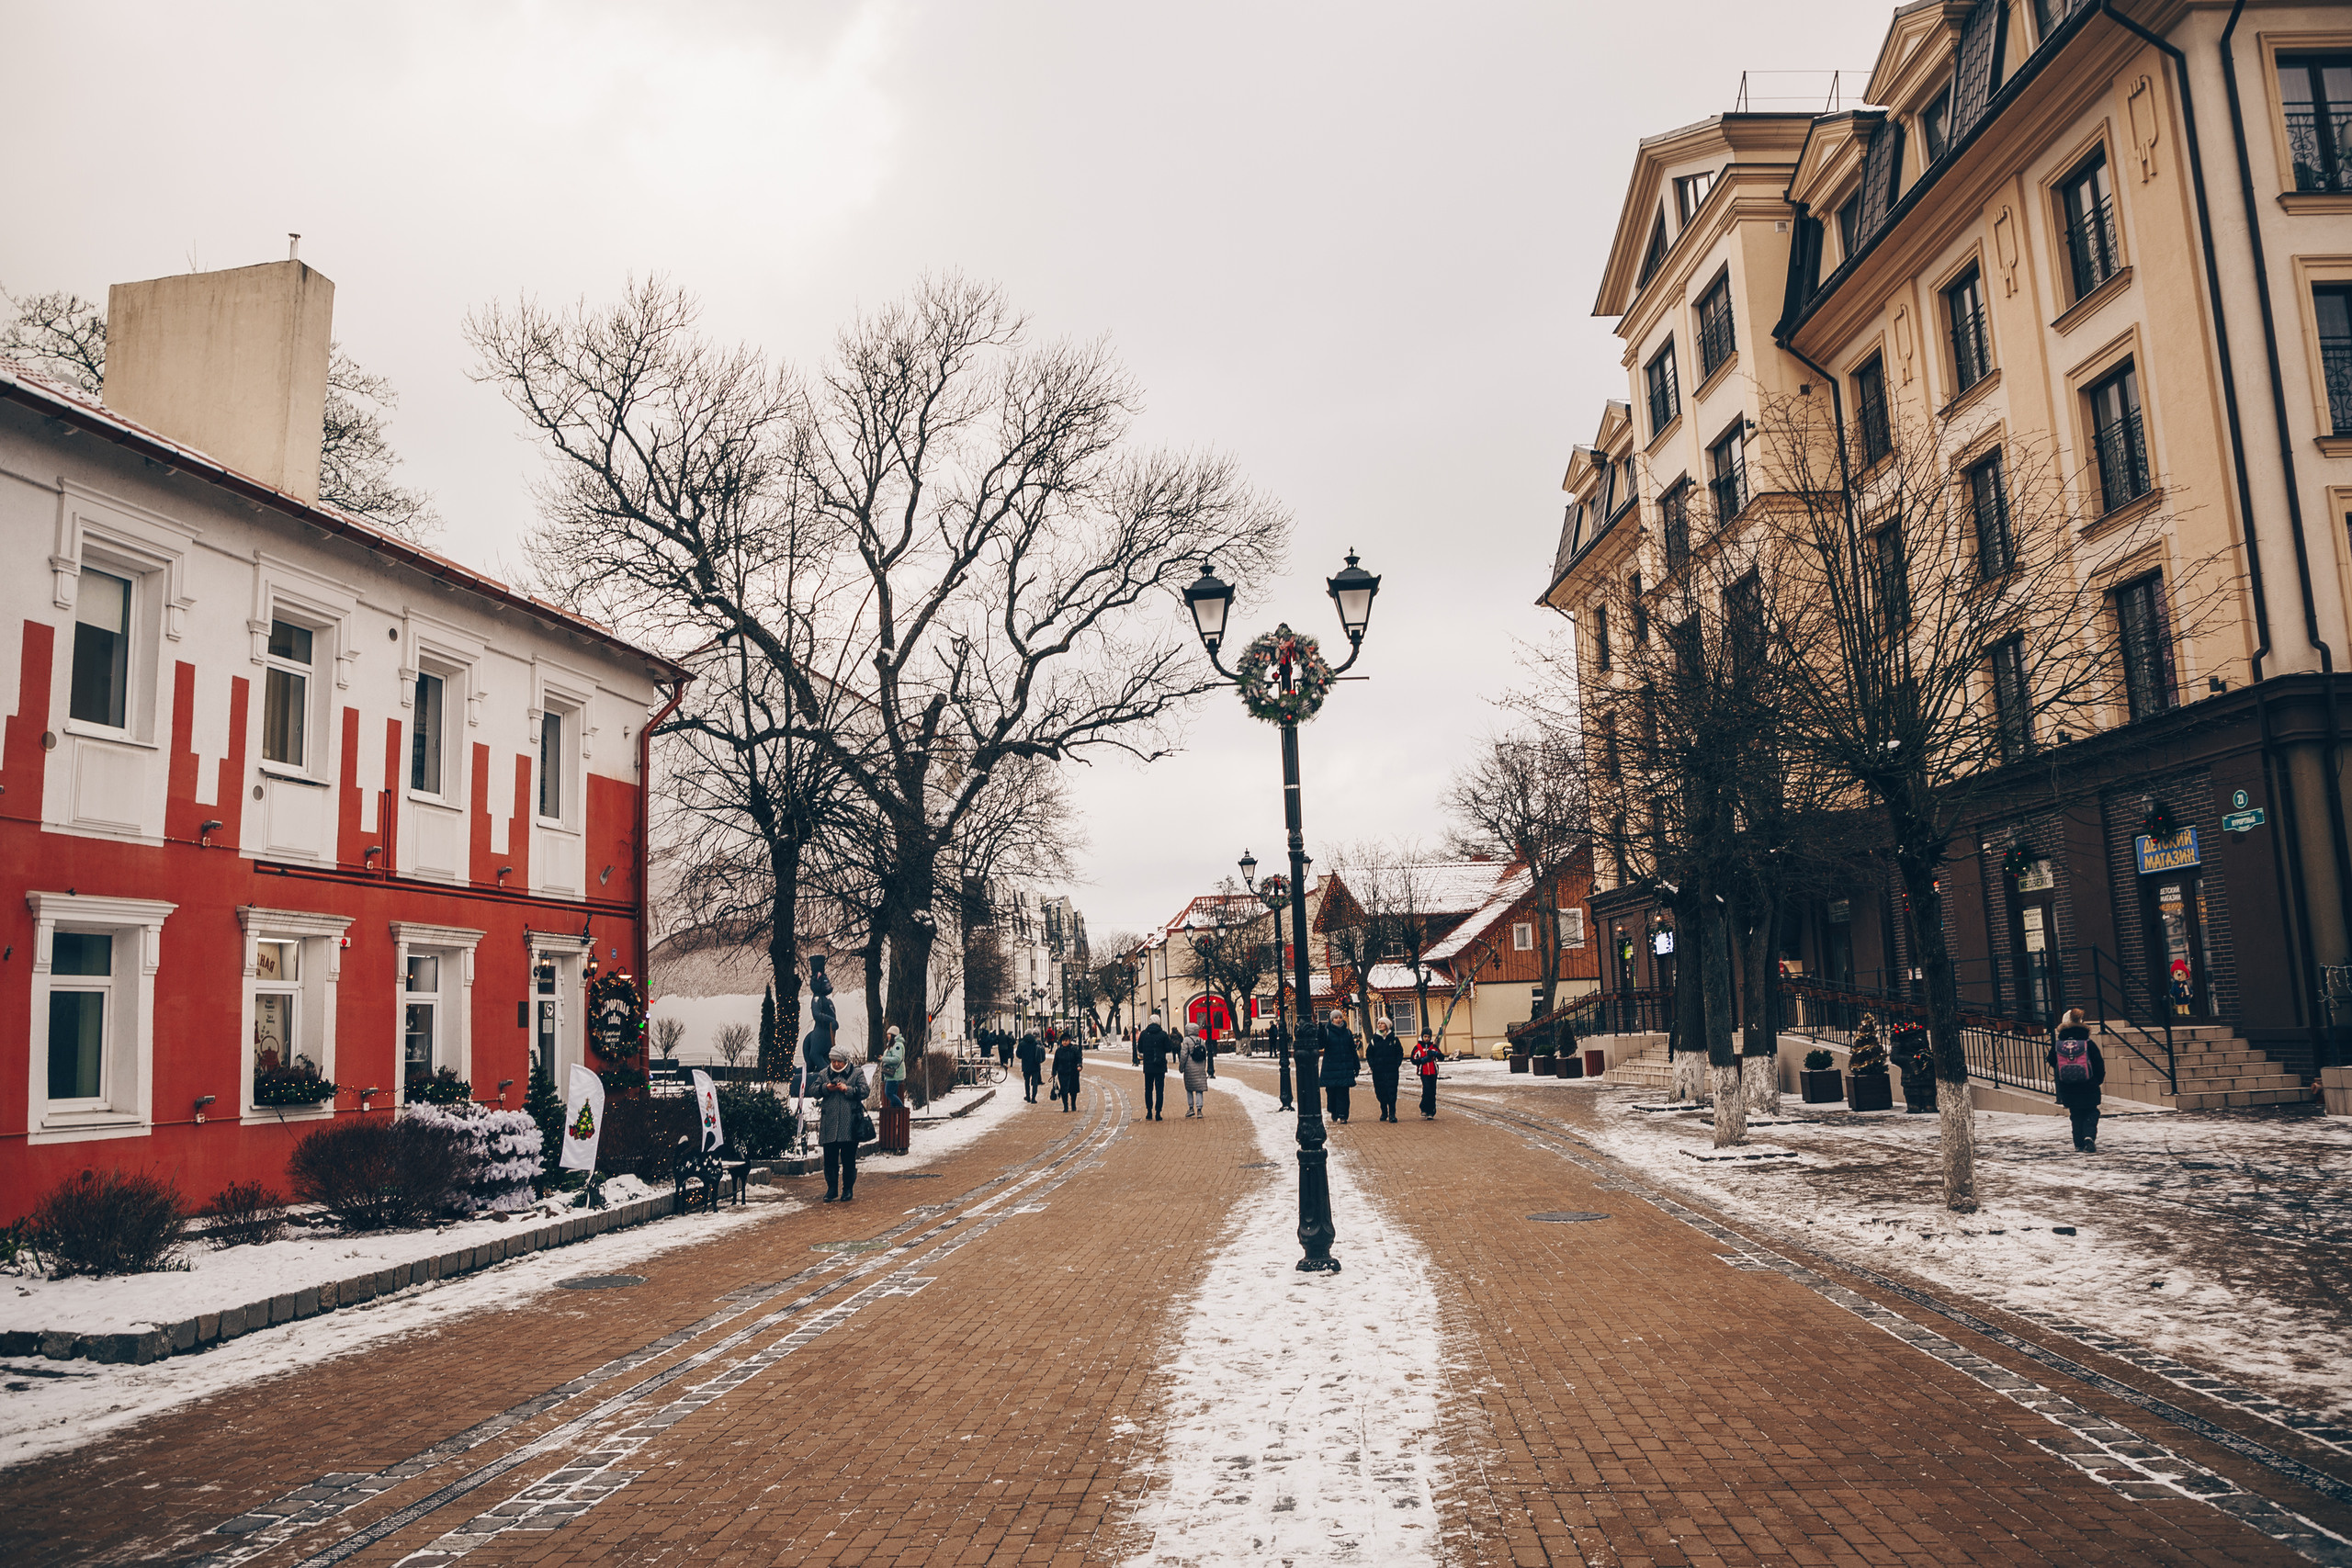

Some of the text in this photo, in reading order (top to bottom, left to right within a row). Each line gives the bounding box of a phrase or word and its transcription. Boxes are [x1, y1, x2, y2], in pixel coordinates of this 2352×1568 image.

[2236, 794, 2245, 805] 21
[2231, 815, 2256, 827] КУРОРТНЫЙ
[2143, 829, 2193, 854] ДЕТСКИЙ
[2143, 847, 2196, 870] МАГАЗИН
